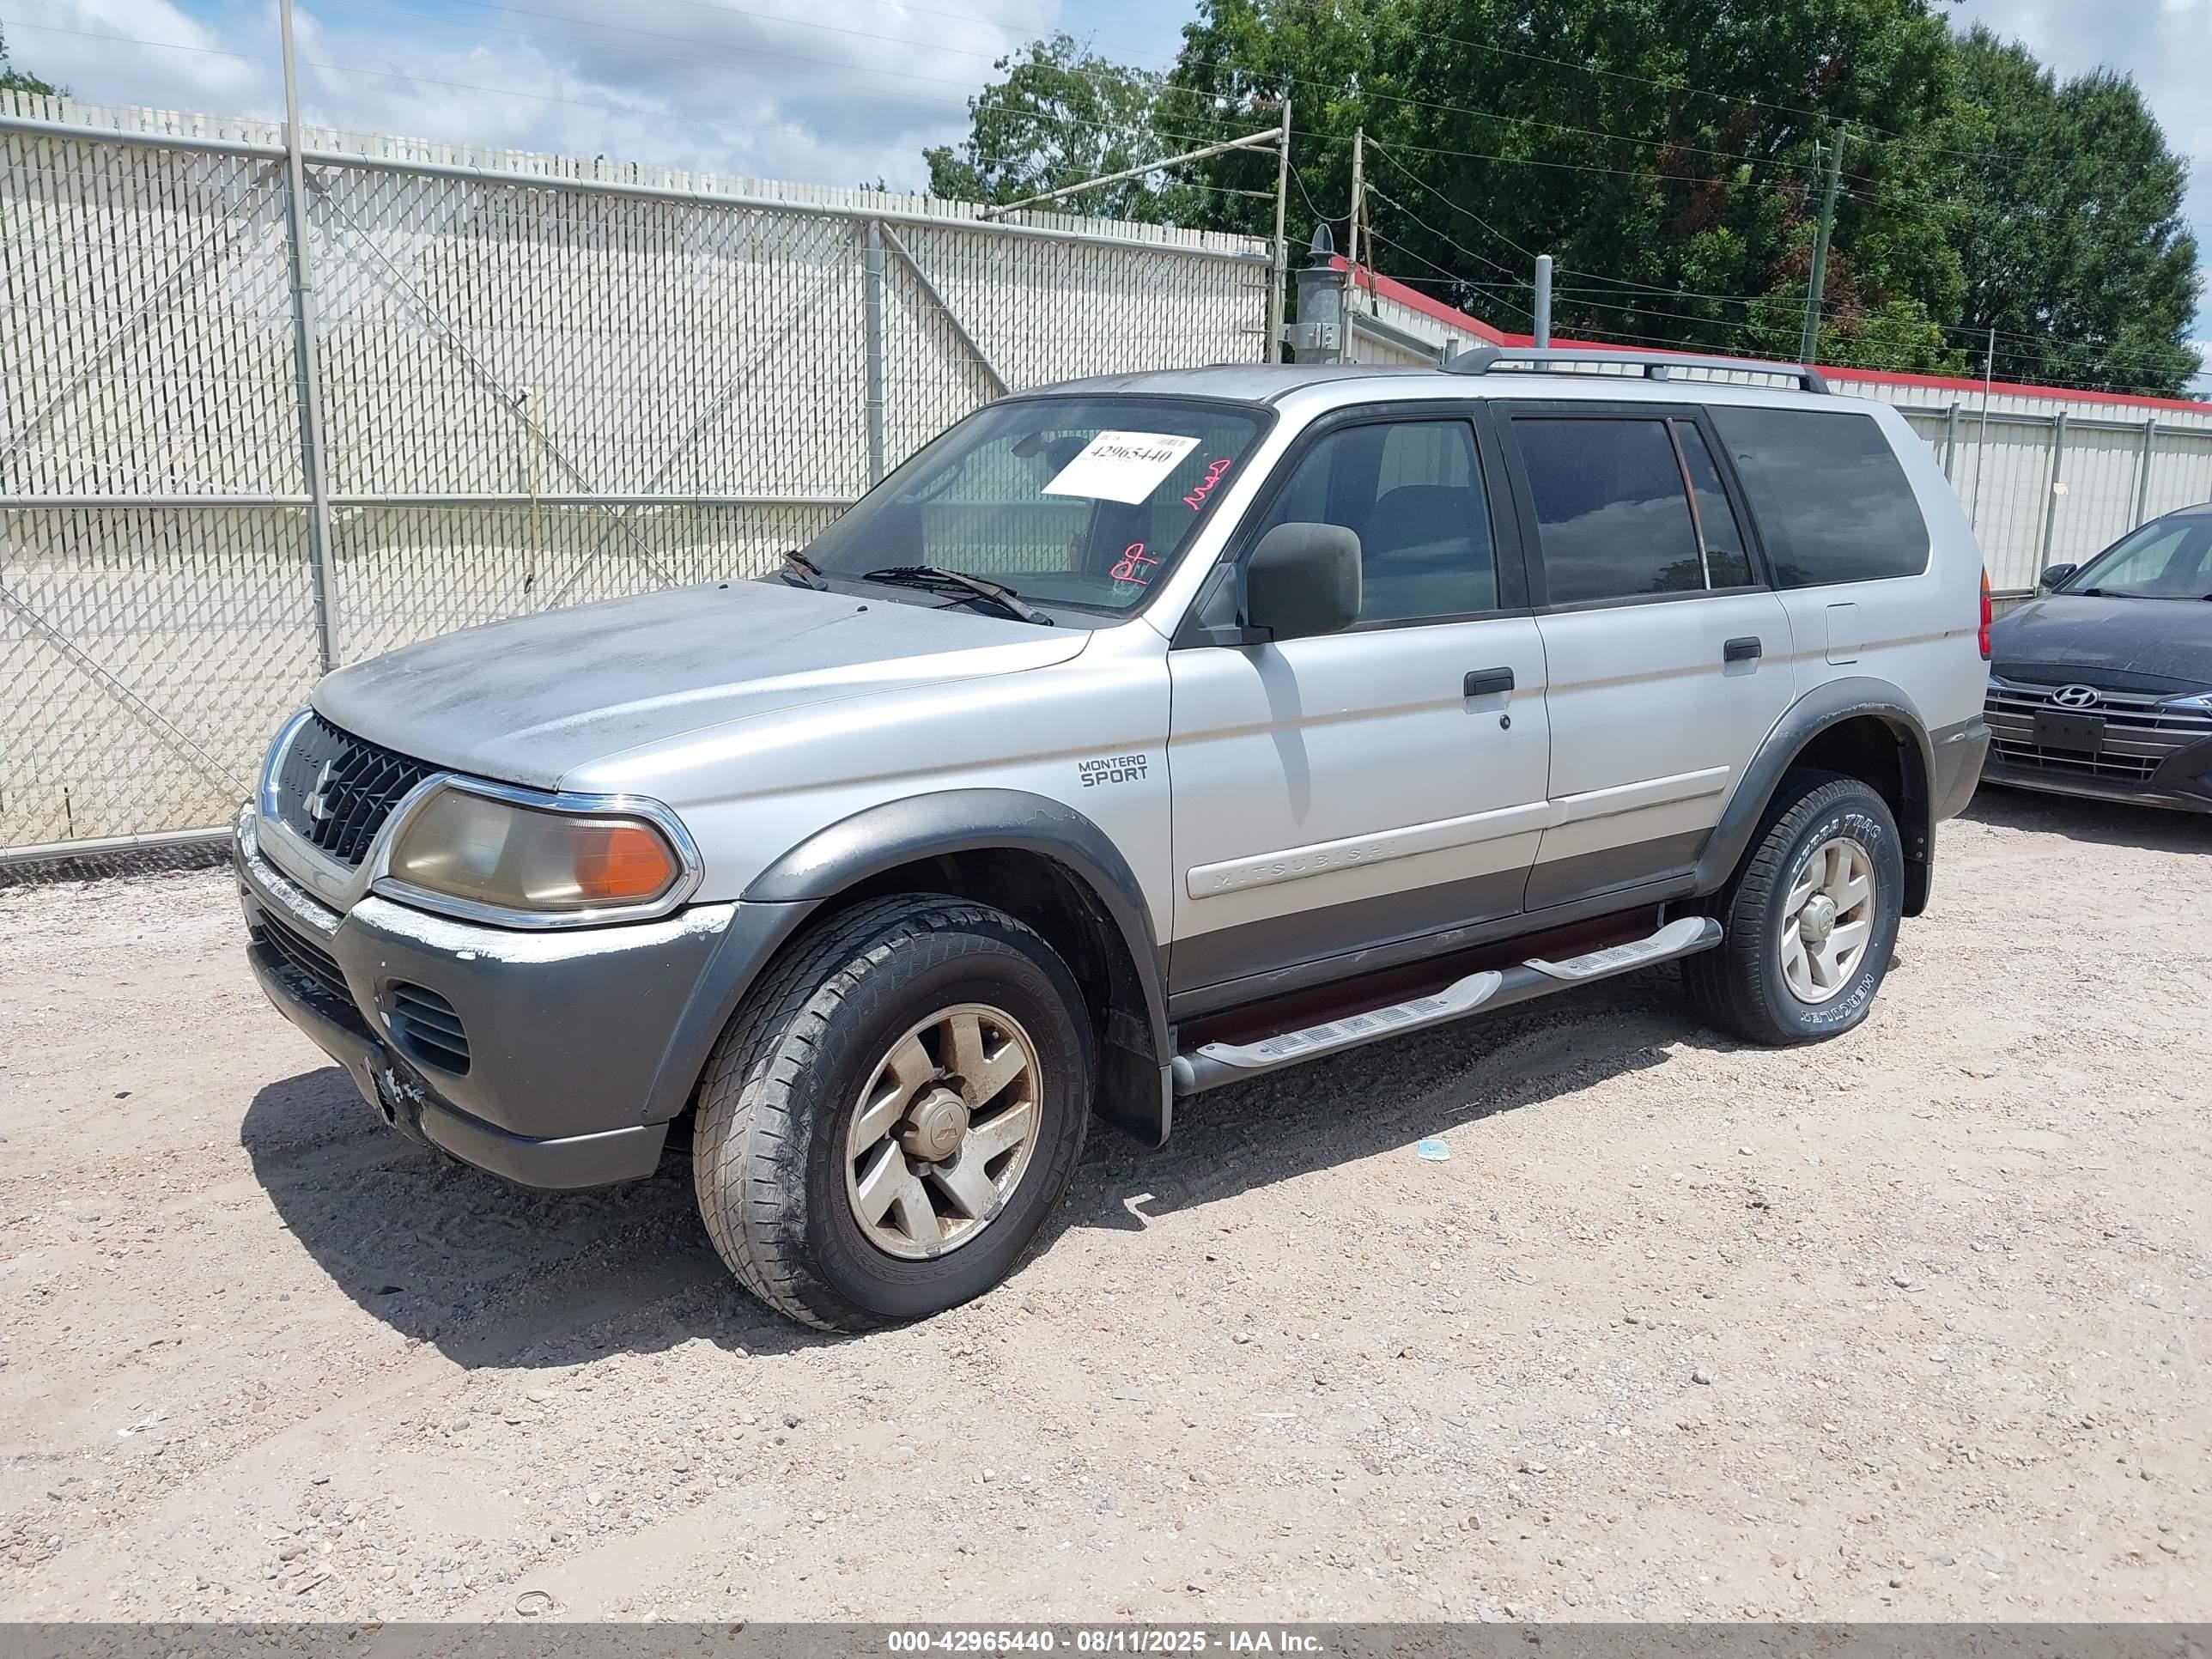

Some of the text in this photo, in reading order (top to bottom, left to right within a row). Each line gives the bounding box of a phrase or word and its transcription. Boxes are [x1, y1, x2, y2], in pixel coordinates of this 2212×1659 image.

[1091, 446, 1173, 463] 42965440
[1078, 754, 1146, 772] MONTERO
[1080, 766, 1148, 787] SPORT
[1845, 814, 1881, 839] TRAC
[1213, 840, 1397, 889] MITSUBISHI
[1800, 974, 1875, 1024] HERCULES
